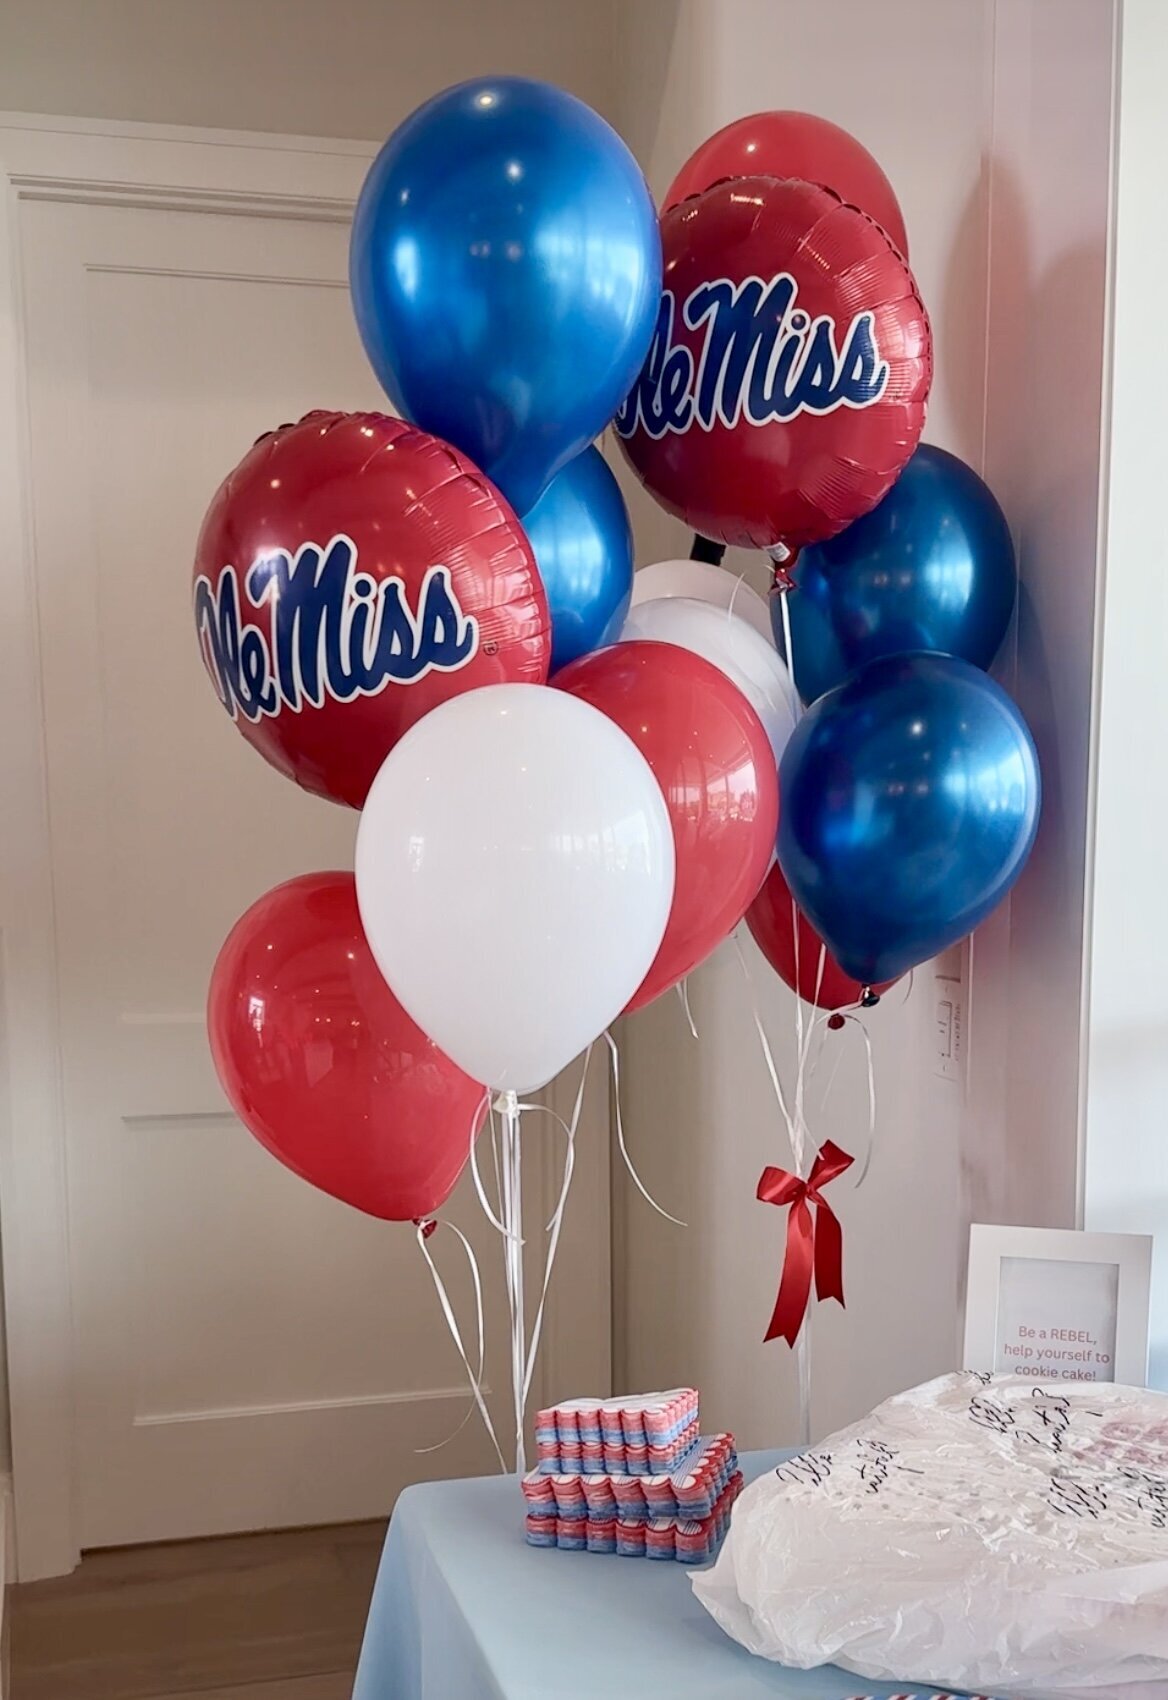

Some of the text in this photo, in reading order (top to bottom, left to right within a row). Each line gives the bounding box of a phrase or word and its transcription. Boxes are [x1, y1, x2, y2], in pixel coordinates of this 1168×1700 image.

[614, 272, 890, 439] le Miss
[246, 534, 479, 709] Miss
[1018, 1326, 1097, 1344] Be a REBEL,
[1004, 1344, 1110, 1364] help yourself to
[1015, 1365, 1096, 1382] cookie cake!
